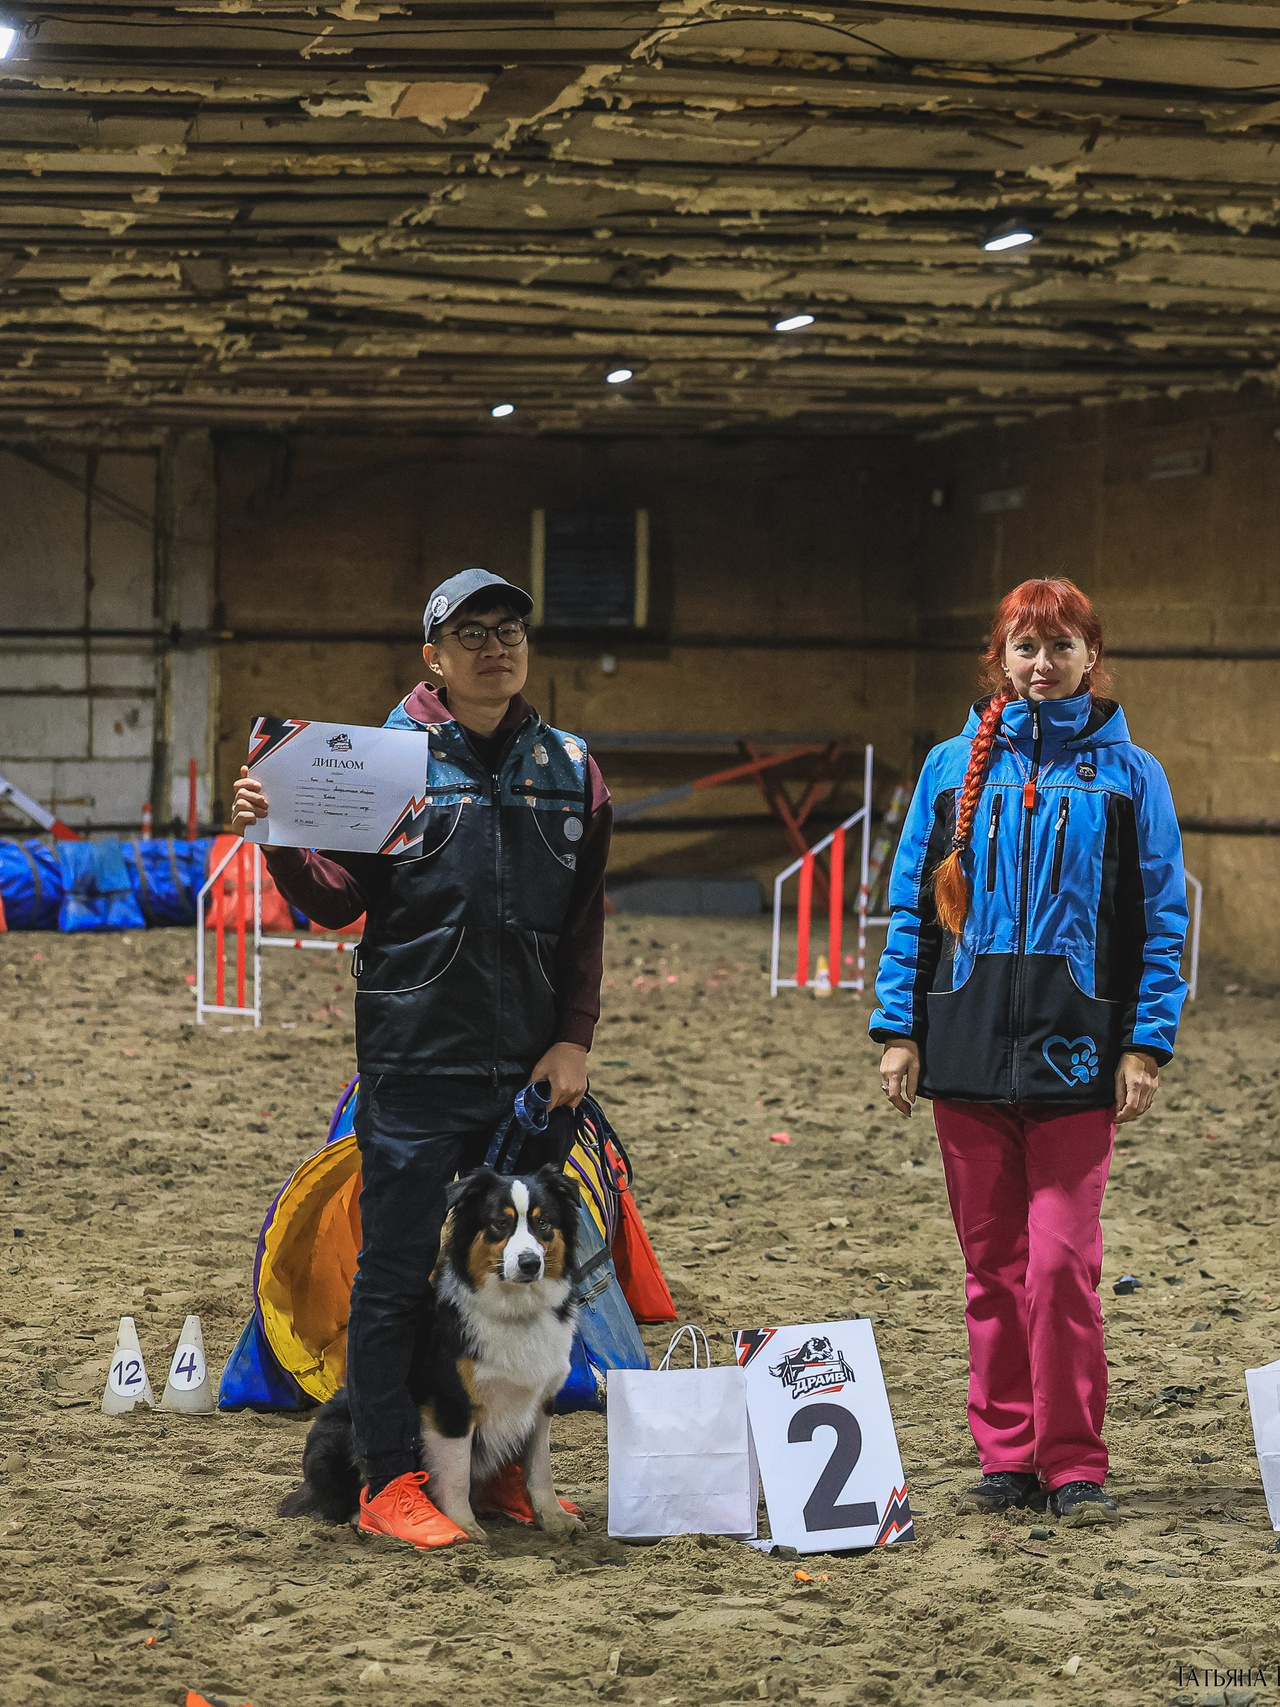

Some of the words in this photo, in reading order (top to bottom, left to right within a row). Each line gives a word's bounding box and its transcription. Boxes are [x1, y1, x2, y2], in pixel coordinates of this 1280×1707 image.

[312, 757, 364, 770] ДИПЛОМ
[113, 1360, 142, 1386] 12
[175, 1352, 197, 1382] 4
[792, 1368, 847, 1397] ДРАЙВ
[787, 1402, 879, 1532] 2
